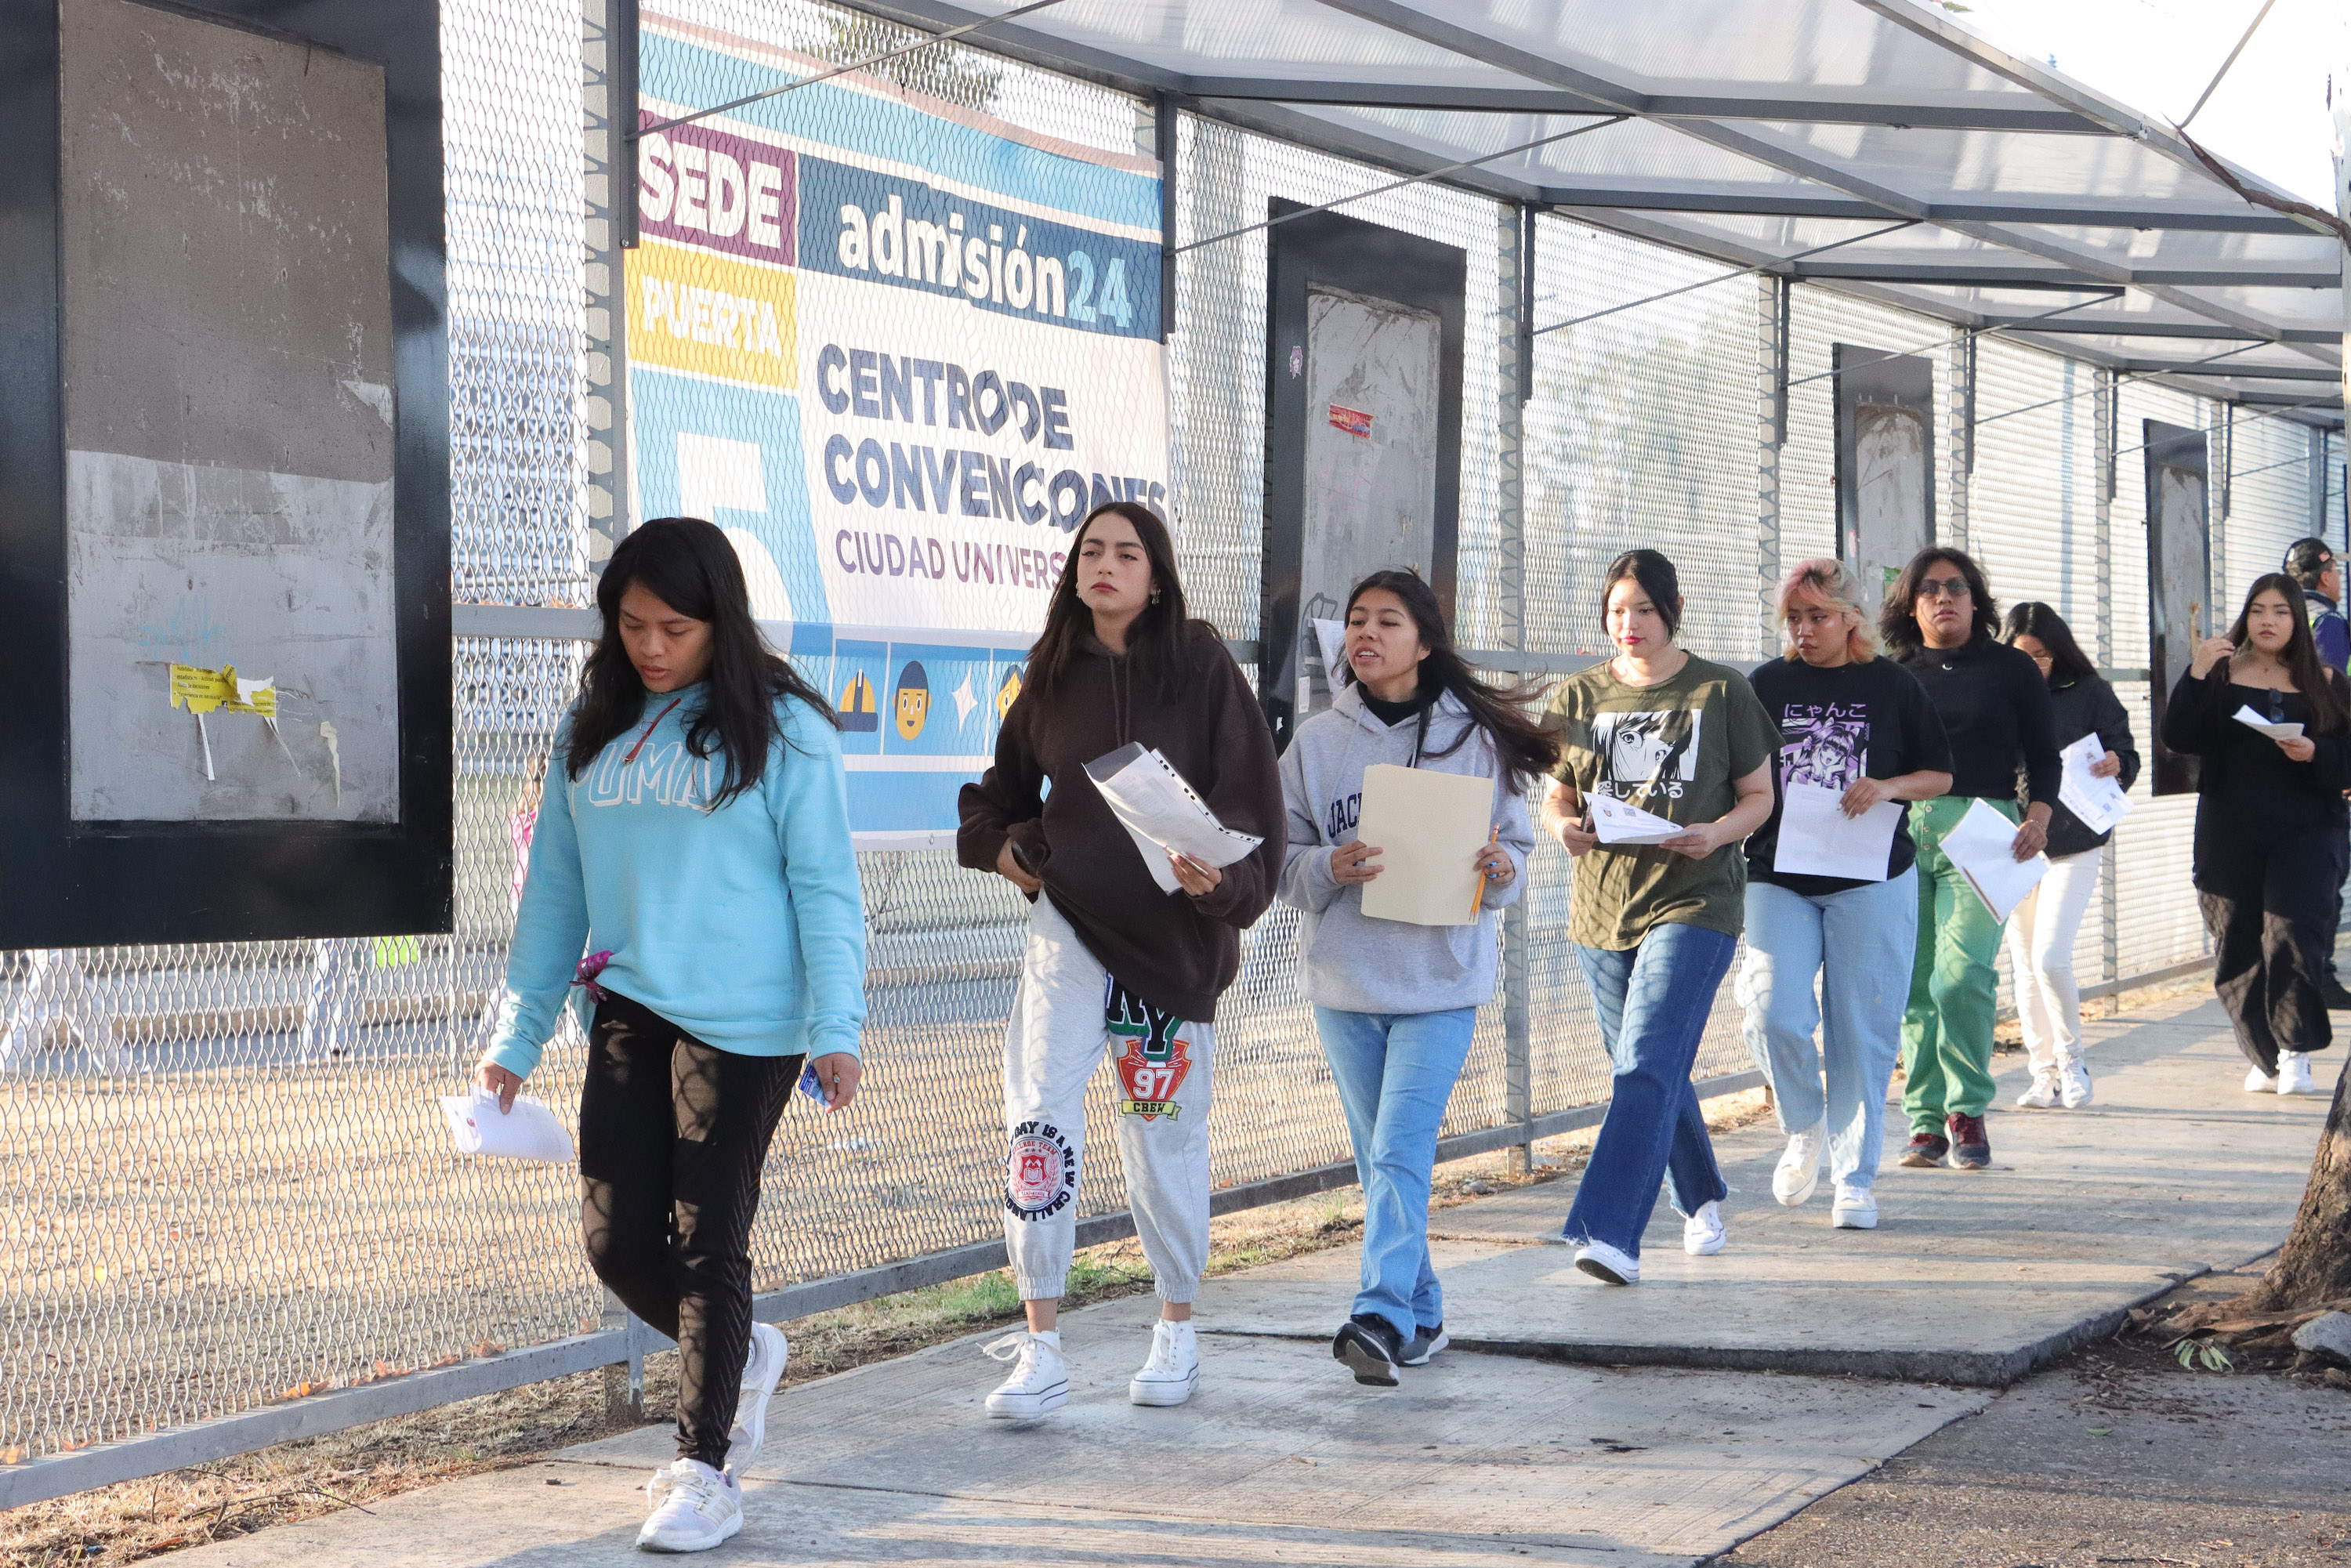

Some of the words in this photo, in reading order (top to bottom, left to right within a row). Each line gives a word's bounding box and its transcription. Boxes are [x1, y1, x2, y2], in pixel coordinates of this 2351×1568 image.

[638, 129, 782, 249] SEDE
[641, 276, 783, 358] PUERTA
[835, 529, 945, 580] CIUDAD
[1784, 702, 1867, 718] にゃんこ
[1132, 1068, 1176, 1099] 97
